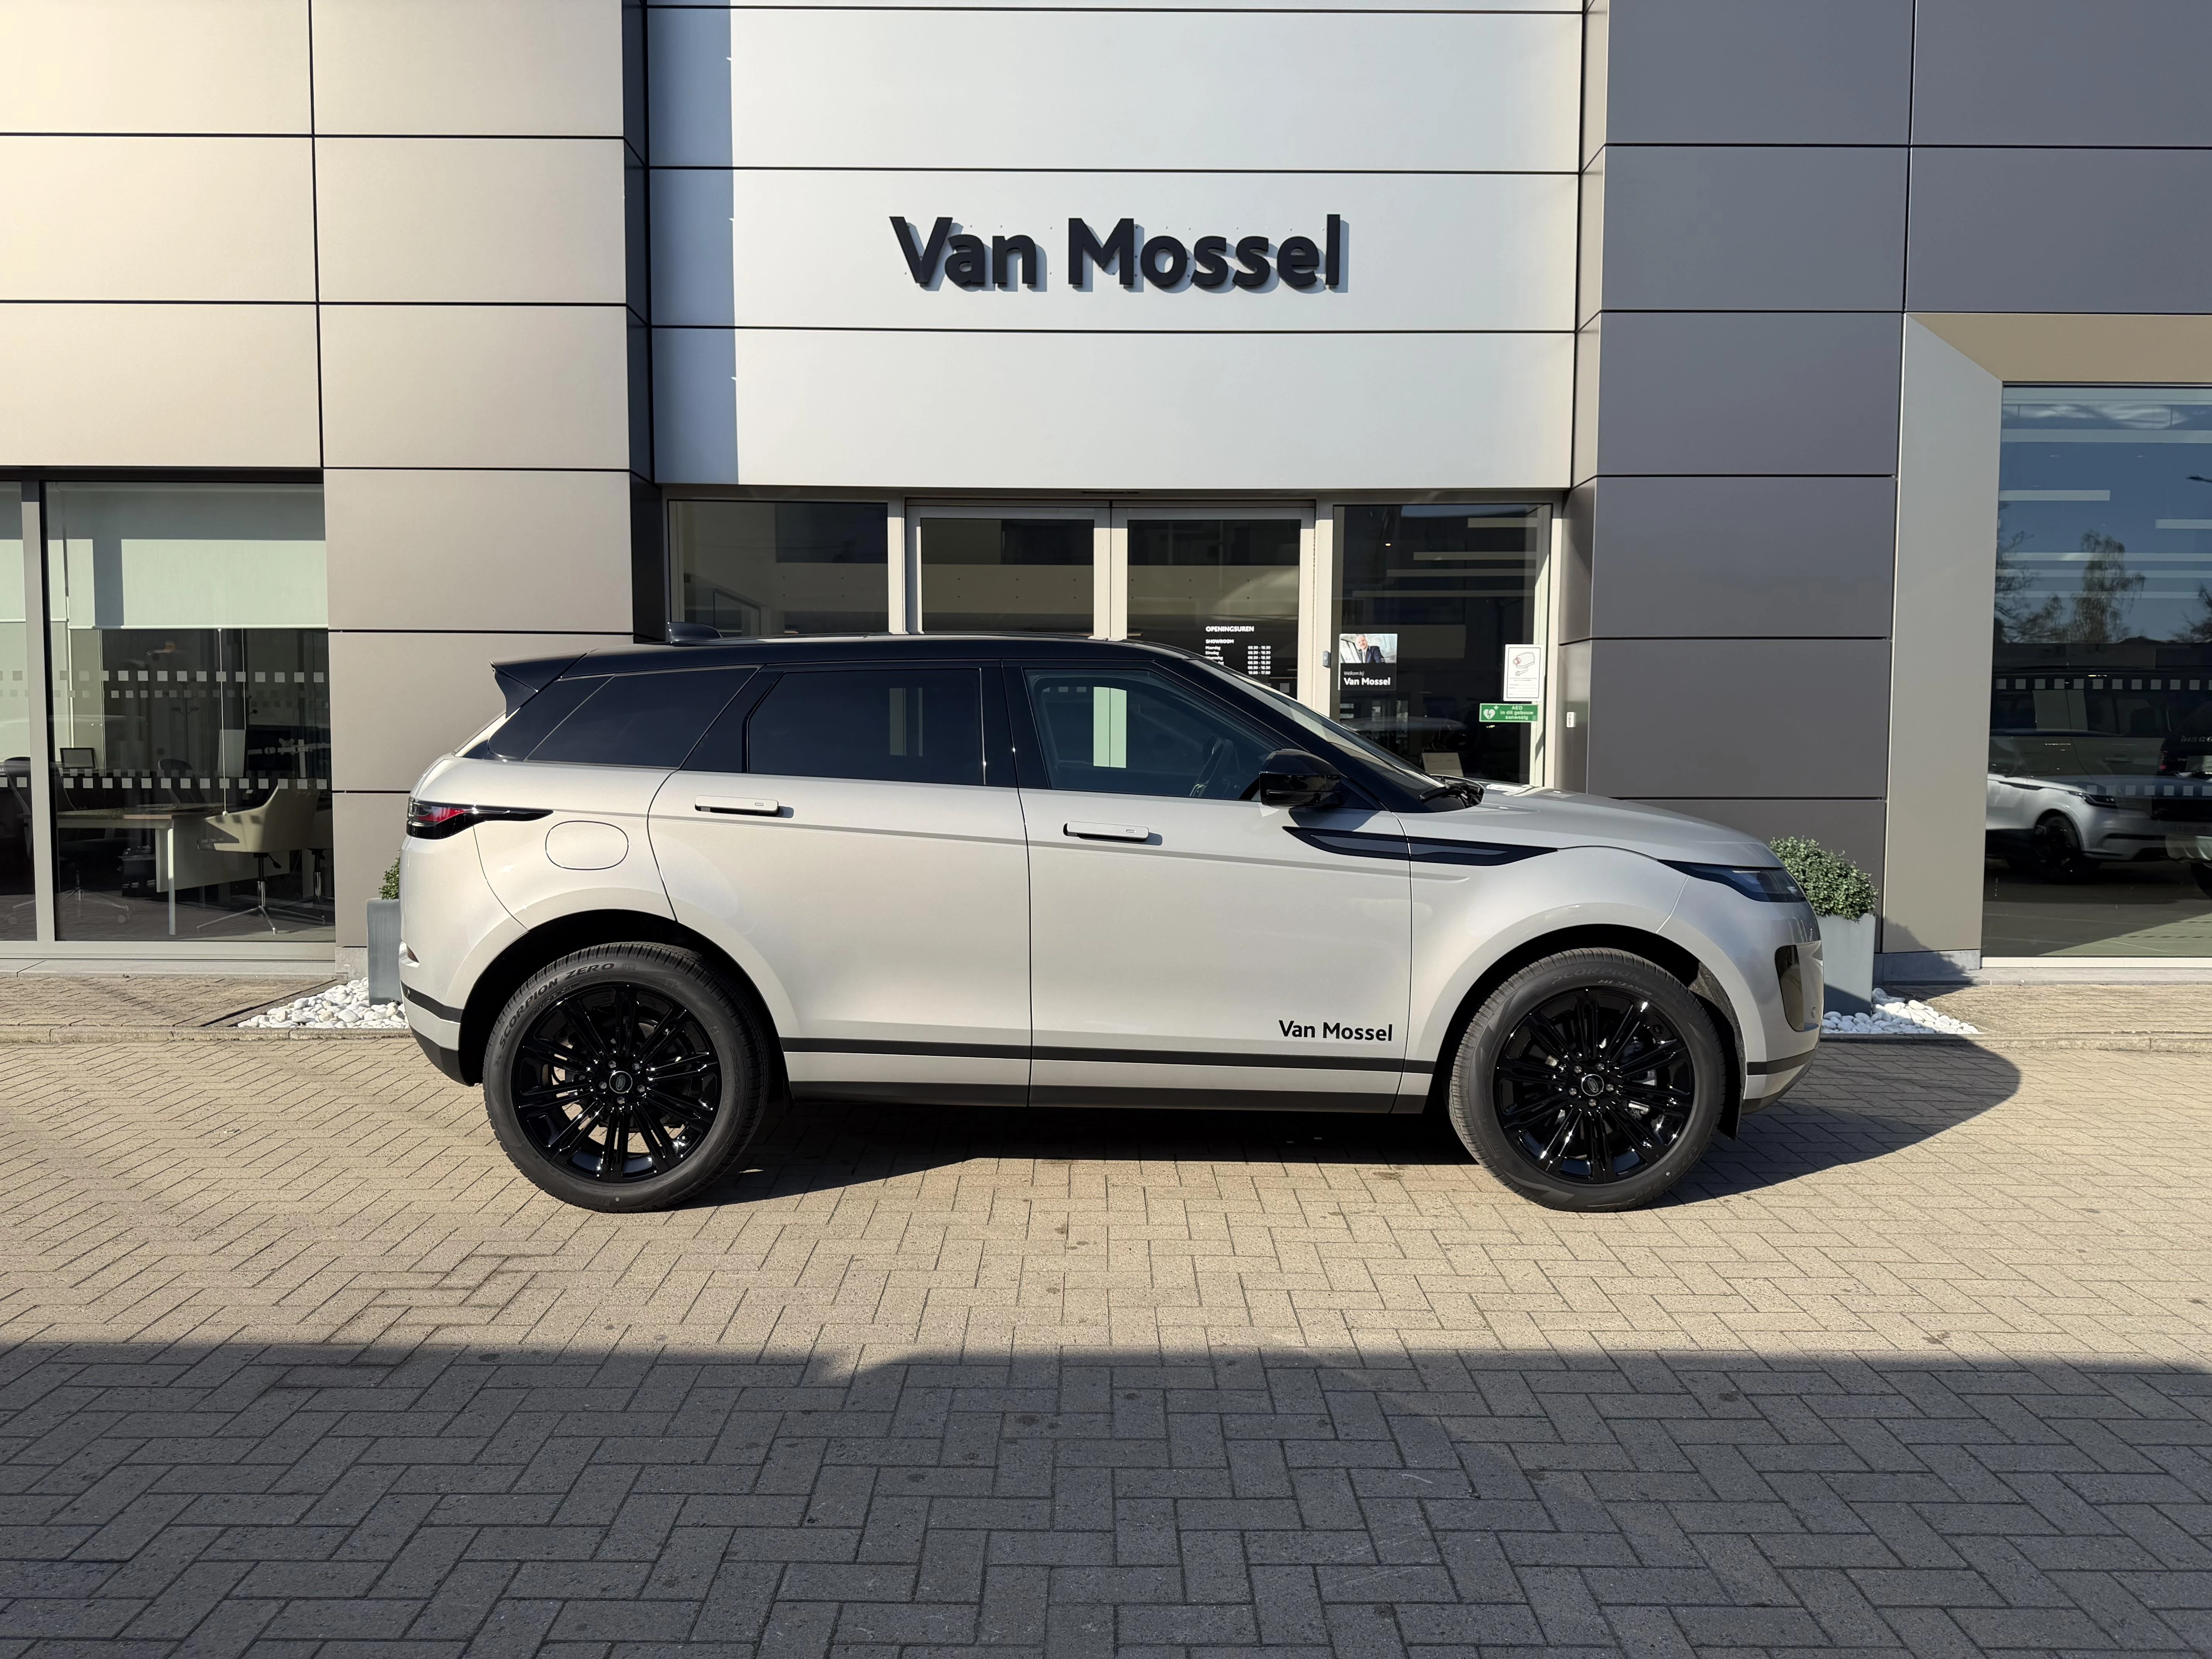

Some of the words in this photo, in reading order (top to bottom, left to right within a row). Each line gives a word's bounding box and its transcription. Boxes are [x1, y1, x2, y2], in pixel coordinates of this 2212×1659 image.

[889, 216, 1037, 286] Van
[1068, 214, 1341, 287] Mossel
[1343, 677, 1360, 685] Van
[1362, 677, 1391, 685] Mossel
[1551, 967, 1642, 985] SCORPION
[500, 977, 558, 1049] SCORPION
[564, 963, 615, 981] ZERO
[1278, 1020, 1316, 1038] Van
[1322, 1022, 1393, 1041] Mossel
